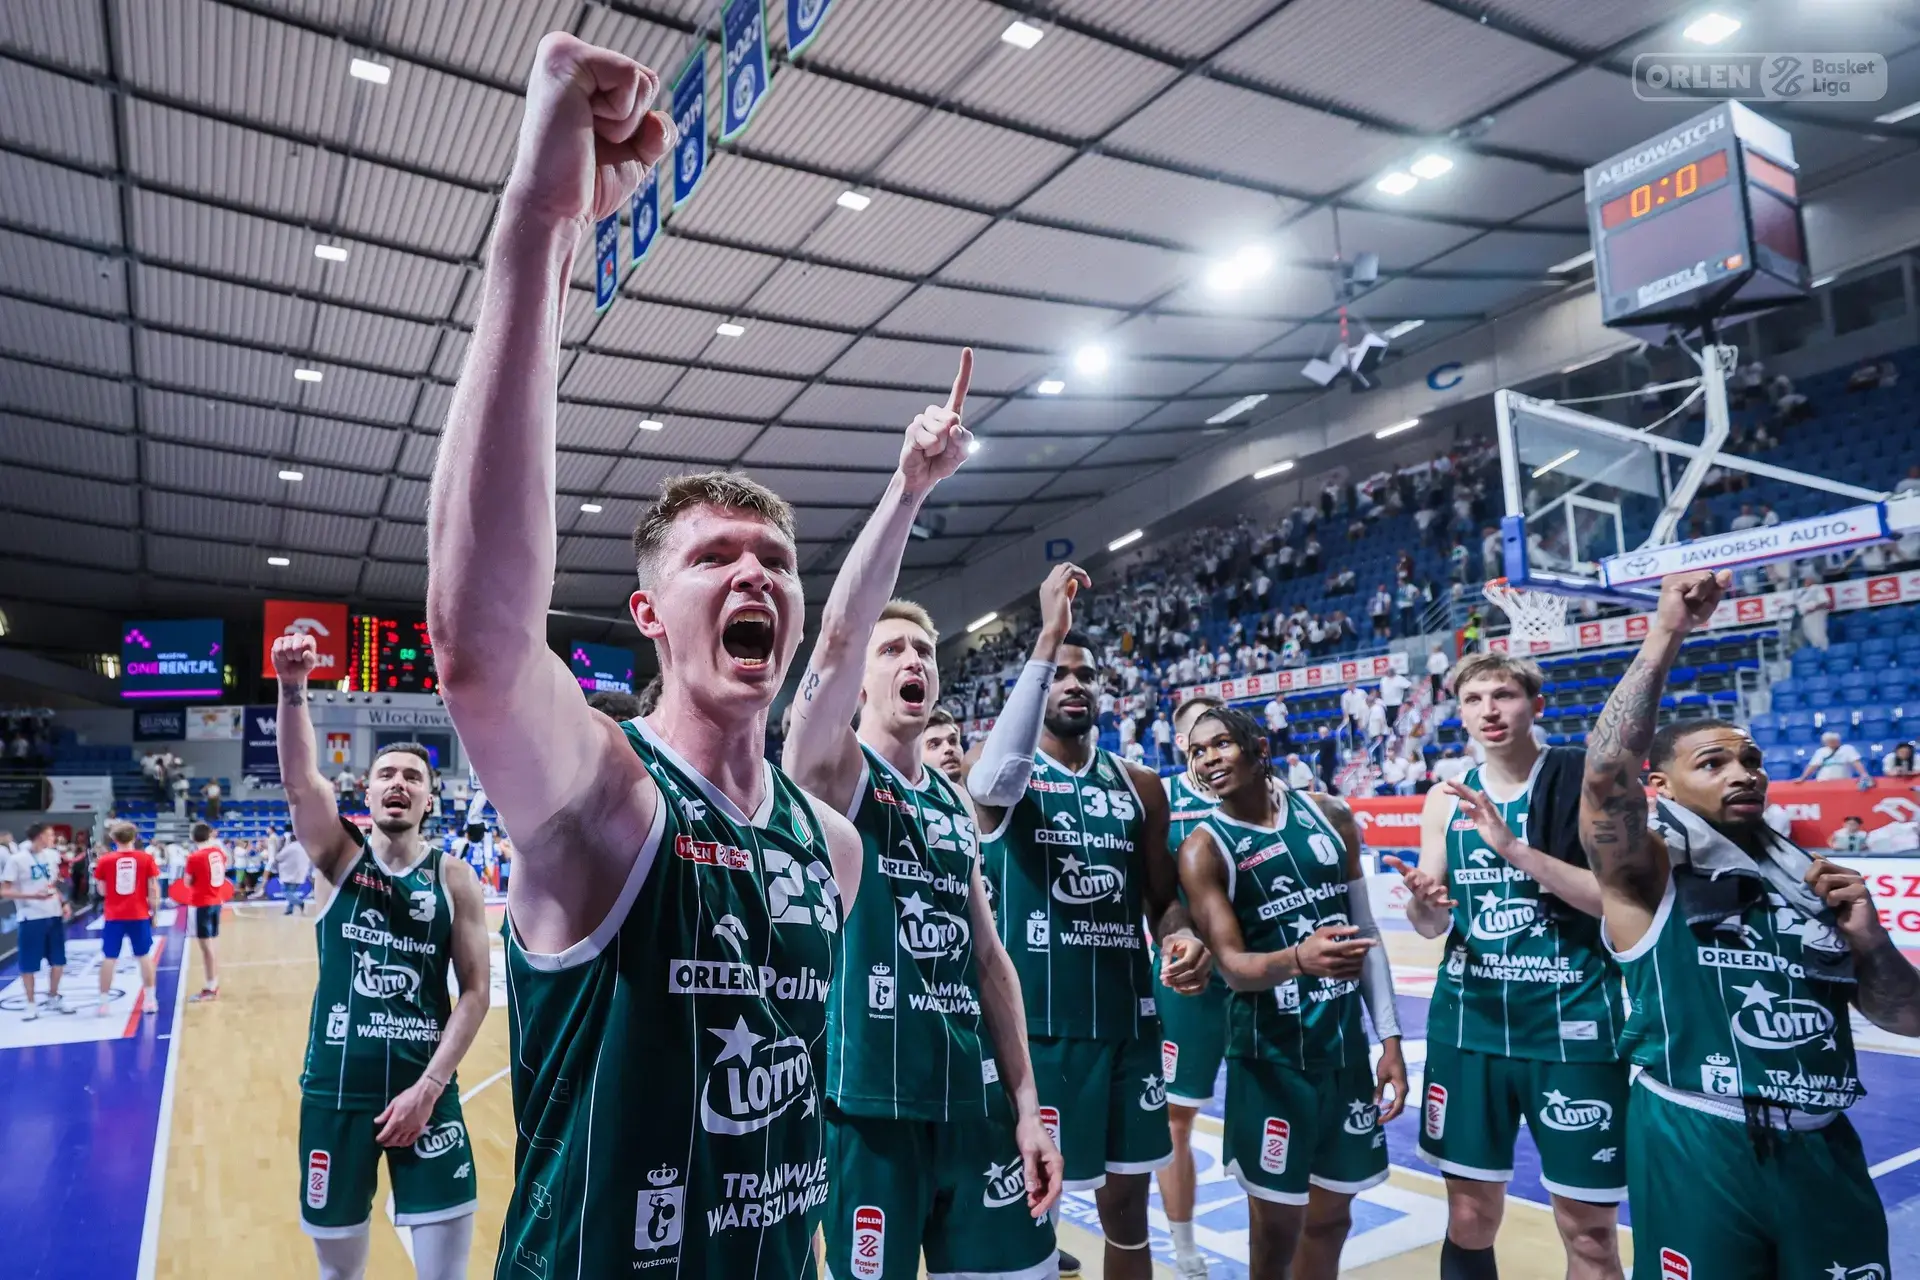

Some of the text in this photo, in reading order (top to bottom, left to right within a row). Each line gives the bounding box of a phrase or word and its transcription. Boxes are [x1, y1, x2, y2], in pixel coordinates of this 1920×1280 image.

[1596, 113, 1725, 187] AEROWATCH
[1630, 163, 1697, 218] 0:0
[1426, 361, 1463, 391] C
[1046, 538, 1075, 561] D
[1681, 536, 1779, 565] JAWORSKI
[1081, 785, 1136, 821] 35
[922, 807, 977, 859] 25
[1037, 830, 1135, 852] ORLEN Paliwa
[763, 849, 841, 934] 23
[1069, 873, 1114, 896] LOTTO
[408, 890, 437, 922] 3
[1262, 892, 1302, 917] ORLEN
[1072, 920, 1136, 936] TRAMWAJE
[1484, 905, 1535, 932] LOTTO
[343, 926, 436, 955] ORLEN Paliwa
[1060, 932, 1141, 950] WARSZAWSKIE
[1481, 953, 1570, 971] TRAMWAJE
[1702, 950, 1770, 968] ORLEN
[363, 970, 407, 993] LOTTO
[675, 964, 831, 1003] ORLEN Paliw
[1470, 965, 1584, 984] WARSZAWSKIE
[356, 1024, 441, 1042] WARSZAWSKI
[369, 1012, 439, 1031] TRAMWAJE
[726, 1052, 809, 1116] LOTTO
[1552, 1103, 1602, 1125] LOTTO
[424, 1127, 458, 1152] LOTTO
[1592, 1147, 1617, 1163] 4F
[453, 1162, 470, 1179] 4F
[993, 1166, 1025, 1198] LOT
[857, 1216, 882, 1225] ORLEN
[632, 1256, 679, 1270] Warszawa
[855, 1258, 880, 1268] Basket
[858, 1266, 874, 1275] Liga
